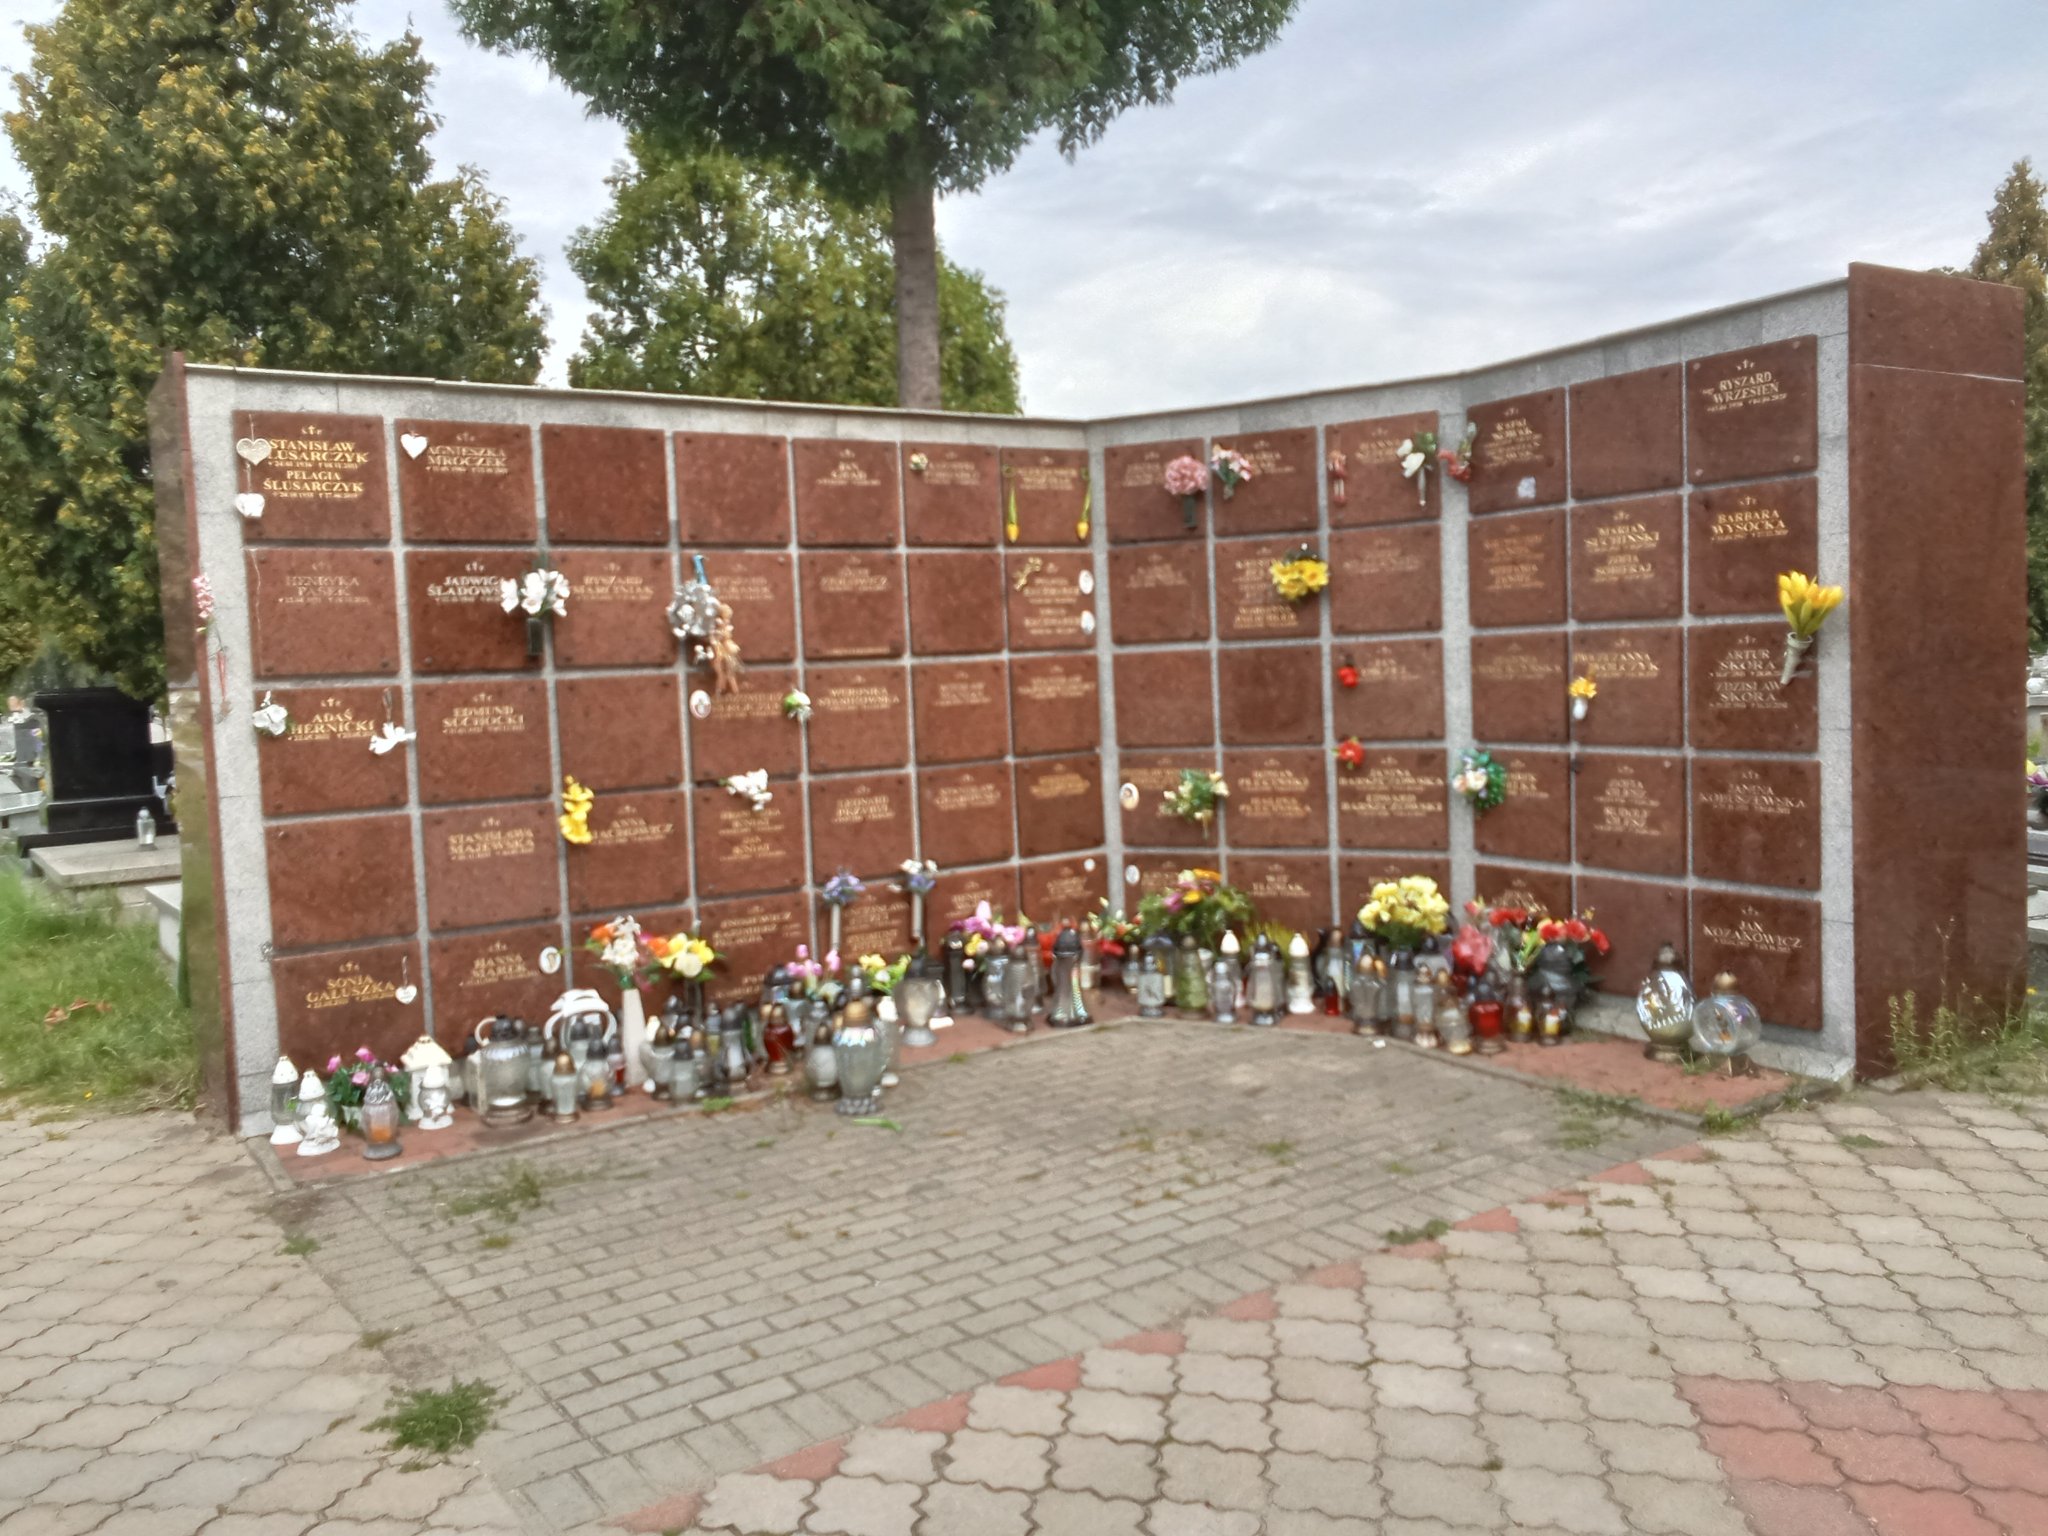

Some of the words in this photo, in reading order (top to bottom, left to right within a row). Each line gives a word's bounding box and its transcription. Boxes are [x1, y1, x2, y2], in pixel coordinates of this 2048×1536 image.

[1719, 371, 1772, 391] RYSZARD
[269, 439, 355, 452] STANISŁAW
[428, 445, 506, 456] AGNIESZKA
[427, 455, 507, 466] MROCZEK
[286, 470, 341, 480] PELAGIA
[263, 478, 365, 492] ŚLUSARCZYK
[1717, 509, 1780, 524] BARBARA
[1711, 519, 1785, 534] WYSOCKA
[286, 575, 360, 586] HENRYKA
[443, 576, 503, 586] JADWIG
[453, 706, 514, 717] EDMUND
[1739, 920, 1764, 932] JAN
[326, 974, 374, 988] SONIA
